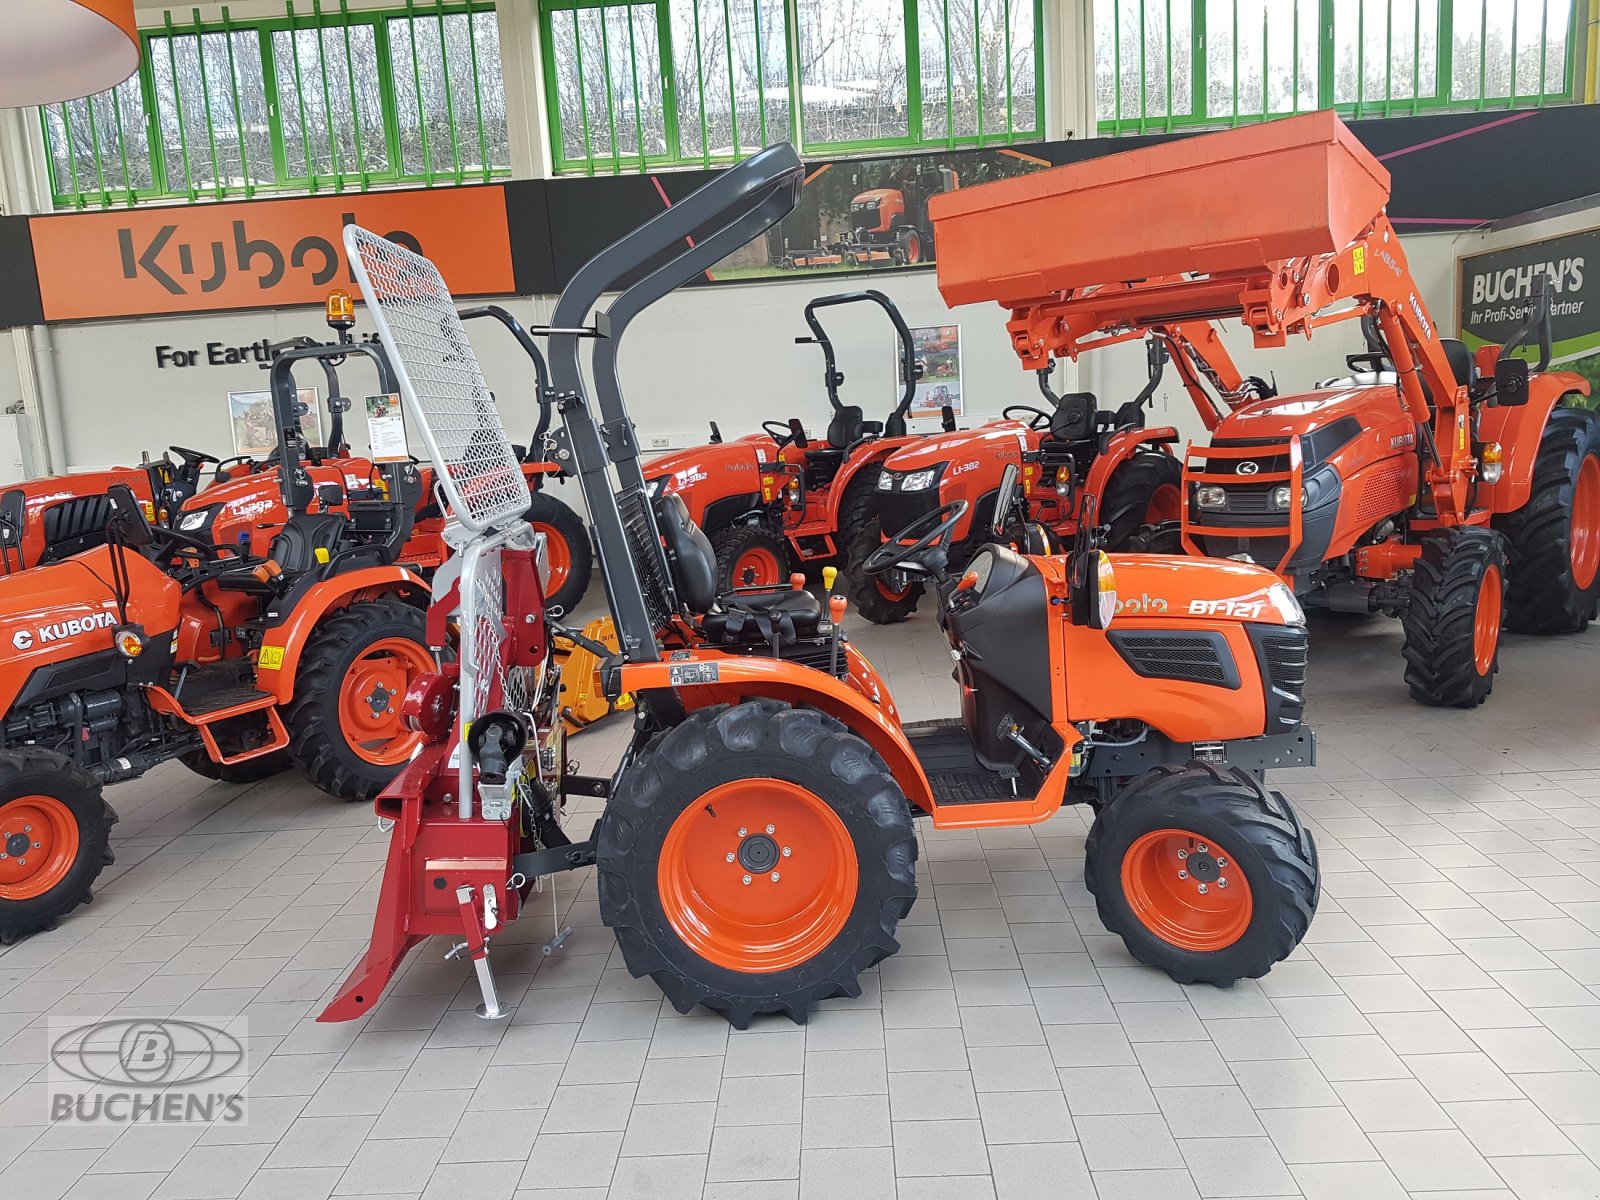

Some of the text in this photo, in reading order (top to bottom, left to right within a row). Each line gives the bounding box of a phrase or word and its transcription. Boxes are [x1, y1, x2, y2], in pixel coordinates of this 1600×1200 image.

[1409, 292, 1431, 341] KUBOTA
[1470, 309, 1483, 325] Ihr
[155, 345, 198, 369] For
[1390, 433, 1414, 449] KUBOTA
[38, 611, 118, 643] KUBOTA
